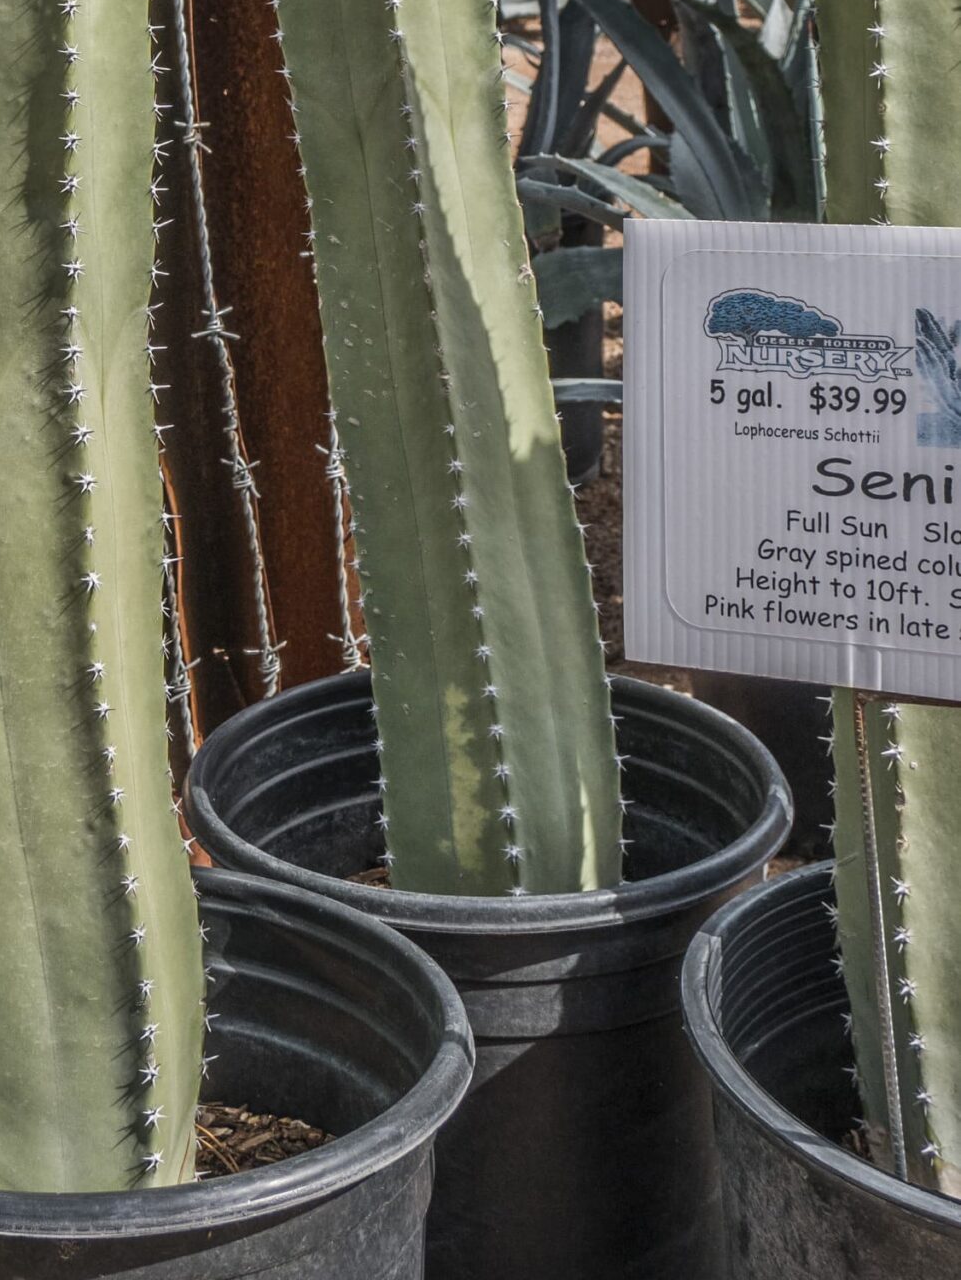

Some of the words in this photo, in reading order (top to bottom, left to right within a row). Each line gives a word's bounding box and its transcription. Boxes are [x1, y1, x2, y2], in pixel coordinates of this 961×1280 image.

[726, 344, 899, 376] NURSERY
[758, 335, 815, 347] DESERT
[823, 338, 888, 350] HORIZON
[710, 379, 726, 405] 5
[736, 380, 783, 415] gal.
[809, 381, 907, 416] $39.99
[734, 421, 820, 441] Lophocereus
[823, 427, 880, 444] Schottii
[811, 457, 955, 505] Seni
[786, 509, 830, 534] Full
[840, 515, 888, 540] Sun
[757, 538, 817, 570] Gray
[825, 546, 908, 574] spined
[736, 566, 821, 599] Height
[829, 577, 857, 599] to
[866, 578, 930, 607] 10ft.
[705, 594, 755, 620] Pink
[762, 599, 859, 631] flowers
[868, 610, 890, 635] in
[900, 612, 951, 640] late
